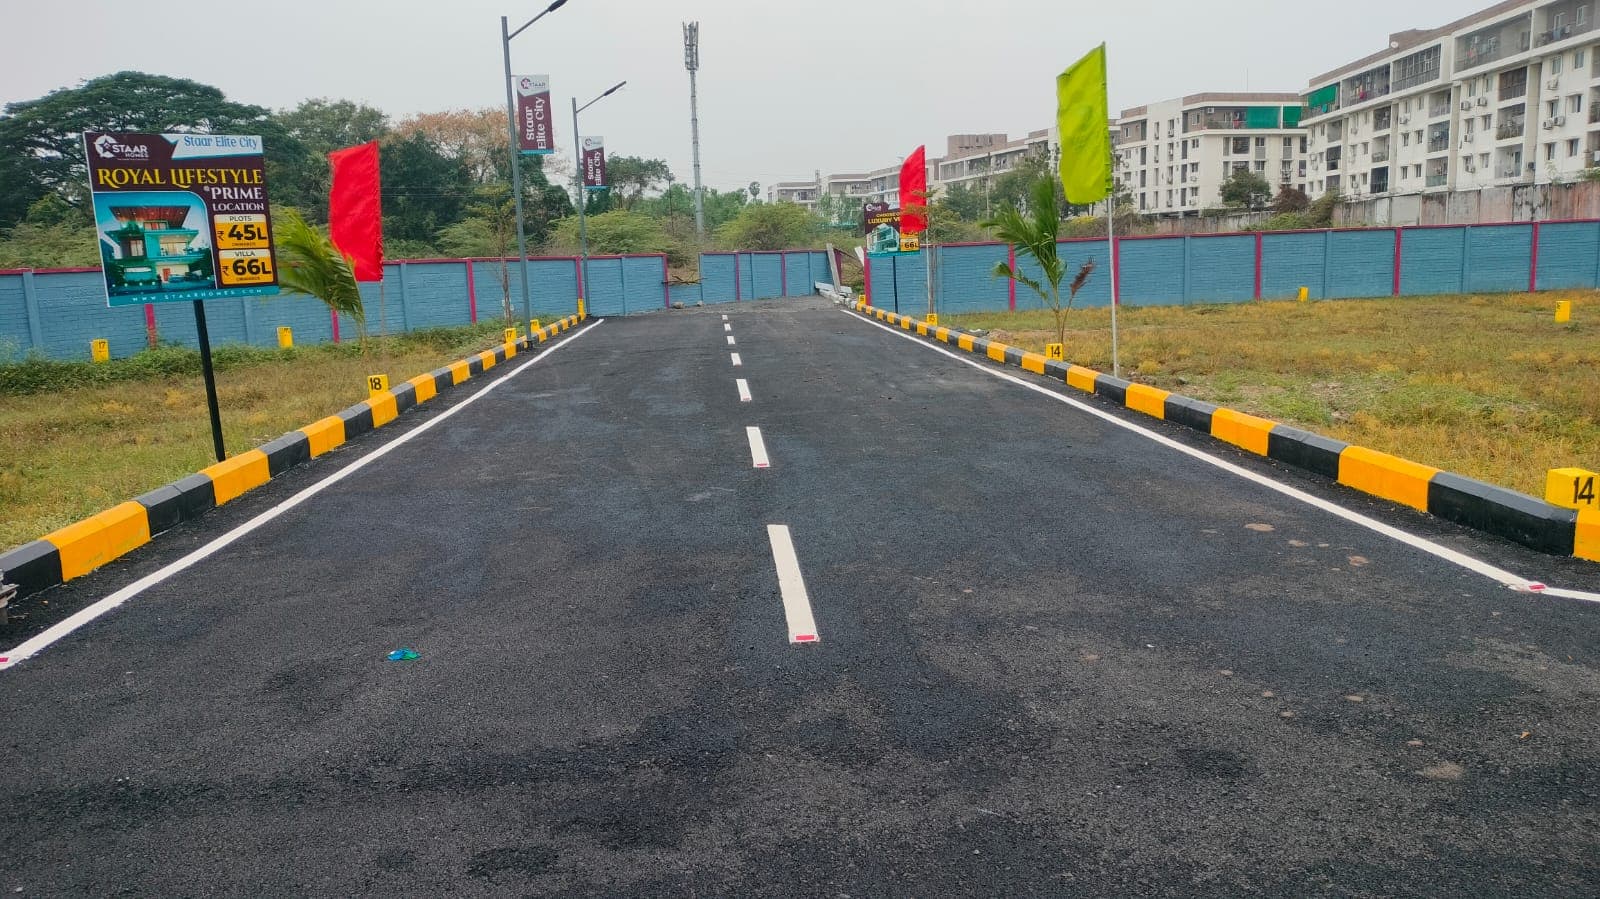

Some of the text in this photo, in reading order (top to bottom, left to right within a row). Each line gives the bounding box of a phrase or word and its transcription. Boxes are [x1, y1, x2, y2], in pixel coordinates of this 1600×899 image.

[534, 97, 545, 121] City
[525, 106, 534, 140] Staar
[183, 135, 257, 150] Staar Elite City
[536, 123, 546, 149] Elite
[112, 144, 148, 153] STAAR
[97, 168, 263, 188] ROYAL LIFESTYLE
[212, 203, 264, 212] LOCATION
[1051, 345, 1061, 358] 14
[369, 377, 382, 391] 18
[1573, 476, 1595, 505] 14
